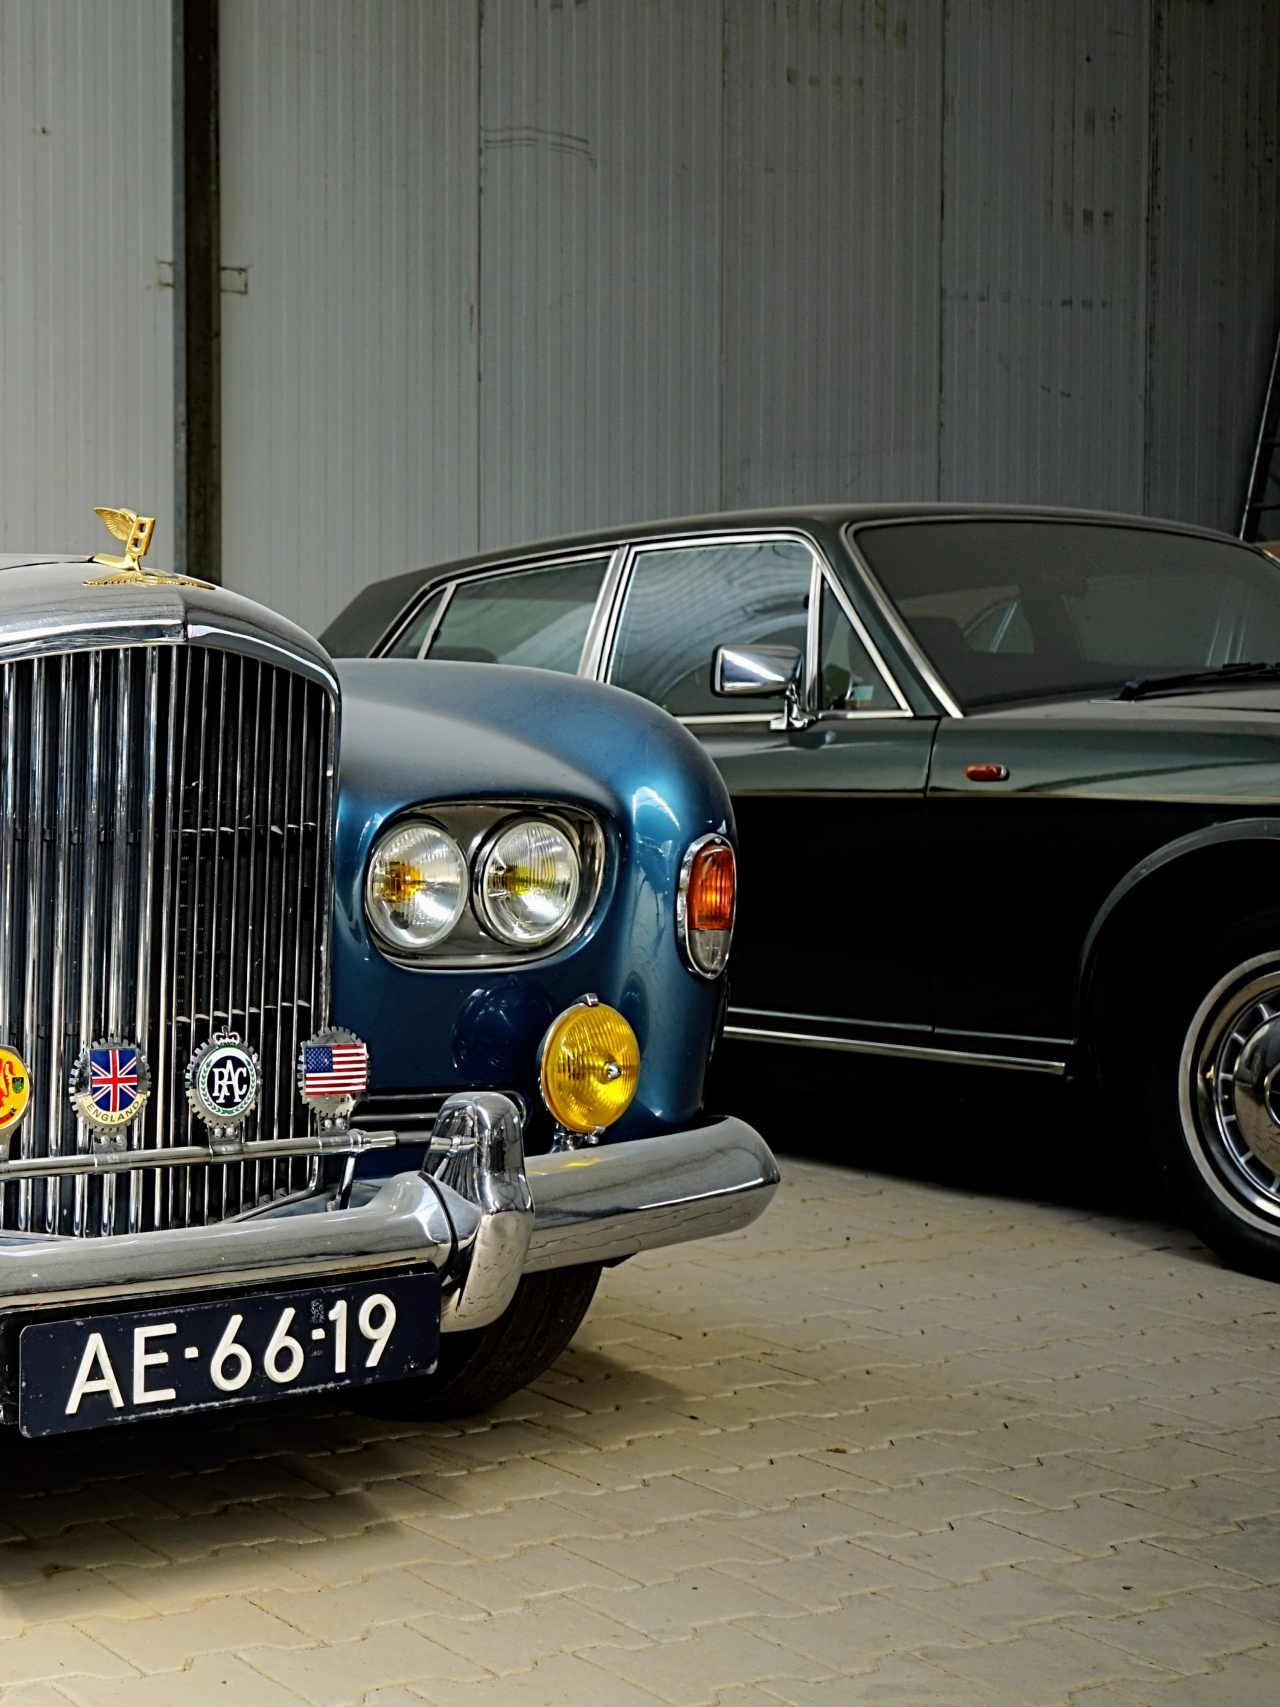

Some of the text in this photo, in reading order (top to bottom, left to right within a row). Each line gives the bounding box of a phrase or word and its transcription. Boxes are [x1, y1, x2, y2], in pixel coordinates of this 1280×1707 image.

[212, 1059, 247, 1103] RAC
[86, 1100, 140, 1122] ENGLAND
[64, 1292, 397, 1416] AE-66-19
